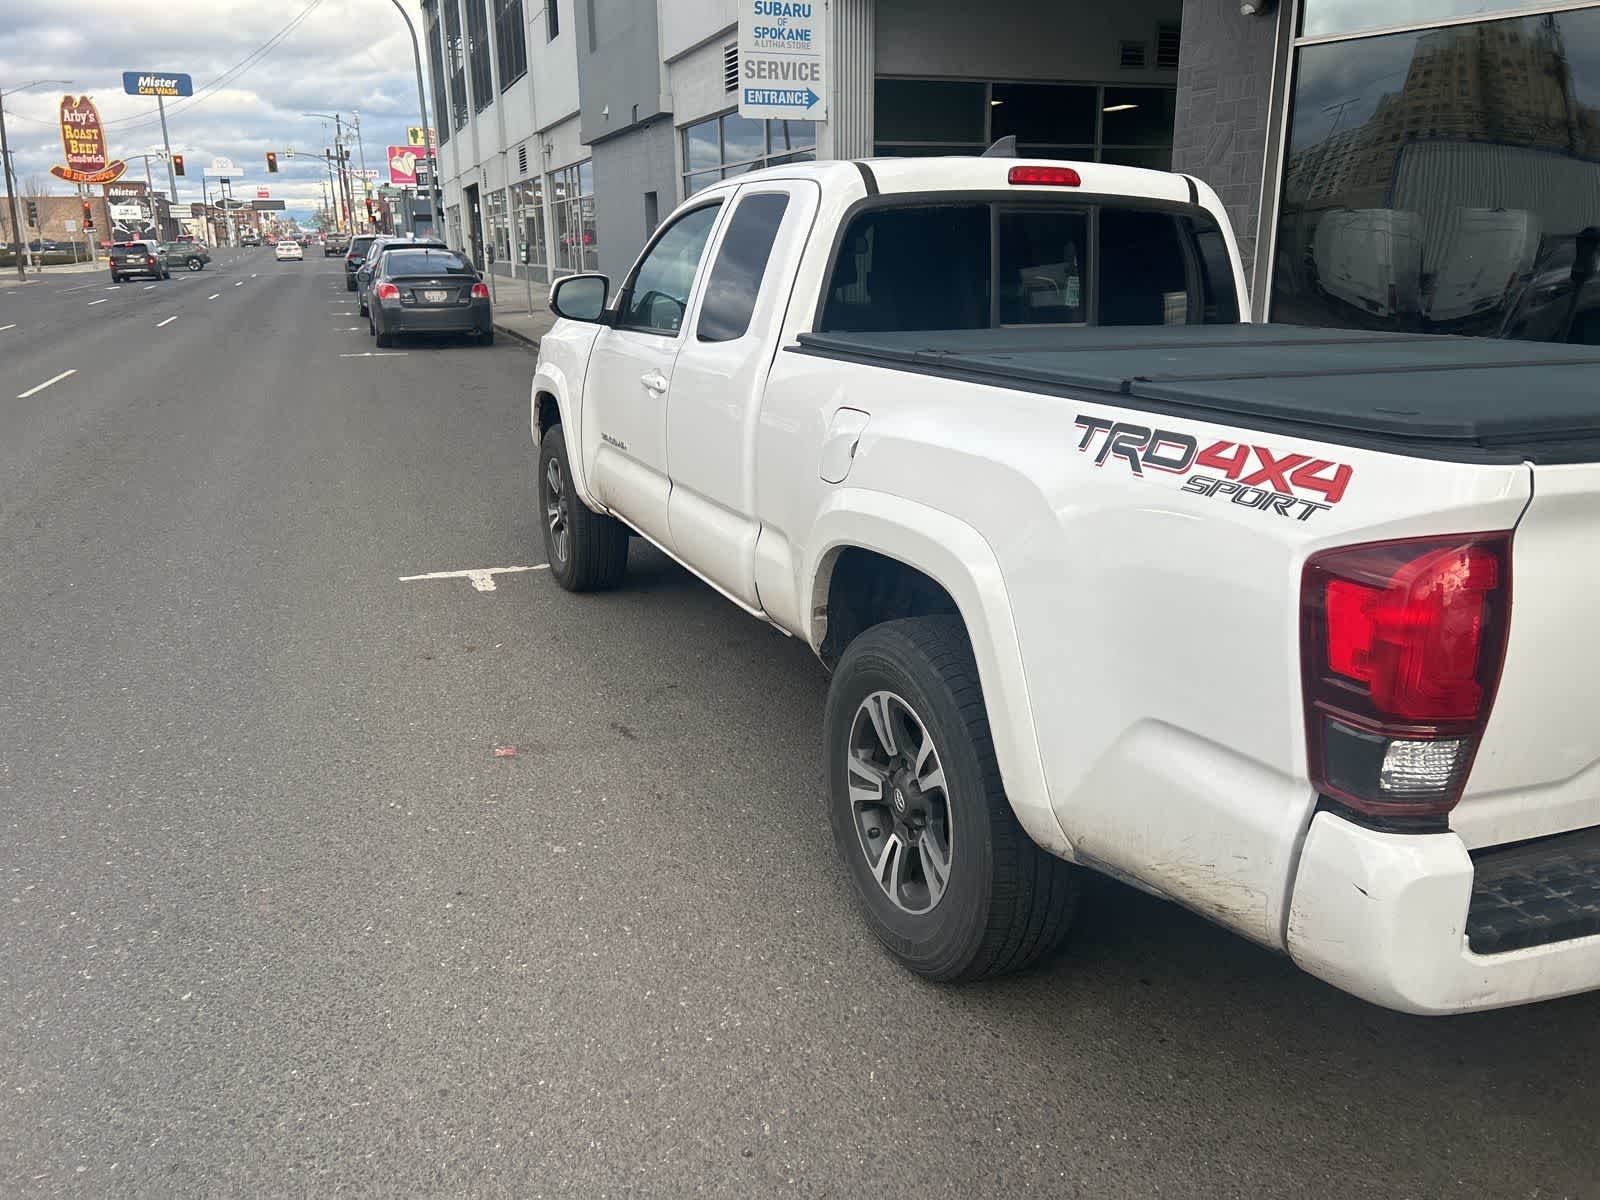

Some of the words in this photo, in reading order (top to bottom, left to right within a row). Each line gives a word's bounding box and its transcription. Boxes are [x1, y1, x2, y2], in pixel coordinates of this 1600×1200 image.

[754, 1, 811, 17] SUBARU
[777, 18, 788, 26] OF
[754, 26, 811, 41] SPOKANE
[754, 40, 760, 48] A
[761, 40, 785, 48] LITHIA
[786, 41, 811, 49] STORE
[744, 59, 820, 81] SERVICE
[138, 76, 178, 88] Mister
[138, 86, 154, 95] CAR
[156, 87, 178, 96] WASH
[747, 90, 809, 105] ENTRANCE
[63, 109, 95, 126] Arby's
[63, 124, 99, 140] ROAST
[69, 140, 98, 154] BEEF
[67, 153, 105, 163] Sandwich
[109, 187, 138, 197] Mister
[1074, 414, 1199, 478] TRD
[1180, 474, 1333, 522] SPORT
